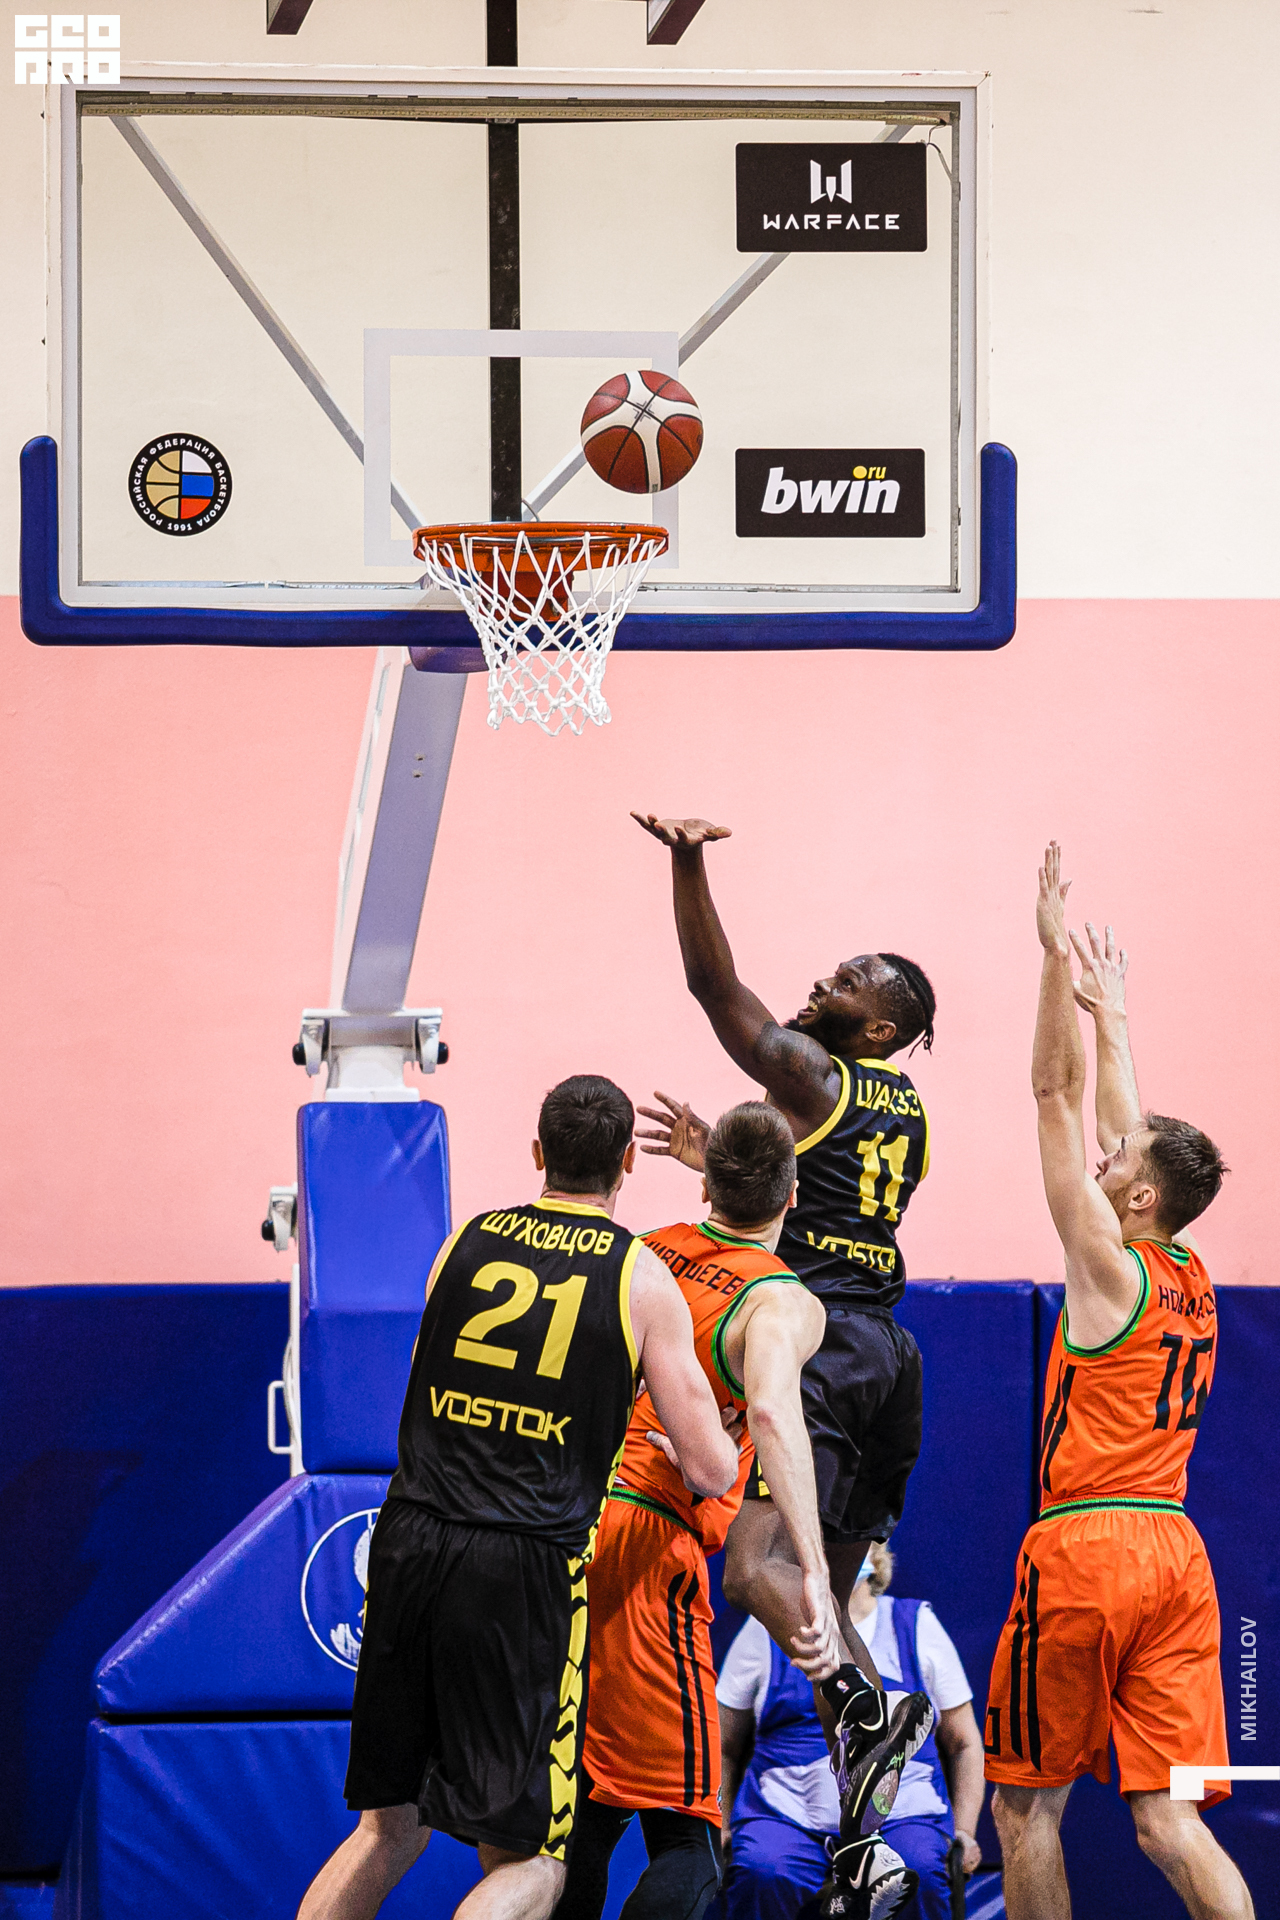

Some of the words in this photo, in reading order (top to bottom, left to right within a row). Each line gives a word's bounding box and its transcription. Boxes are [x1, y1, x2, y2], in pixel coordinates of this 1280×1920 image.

[763, 213, 900, 230] WARFACE
[149, 438, 216, 460] ФЕДЕРАЦИЯ
[133, 456, 163, 526] РОССИЙСКАЯ
[196, 461, 228, 527] БАСКЕТБОЛА
[761, 465, 901, 514] bwin
[167, 522, 193, 531] 1991
[857, 1131, 910, 1222] 11
[480, 1211, 615, 1257] ШУХОВЦОВ
[806, 1230, 896, 1274] VOSTO
[453, 1261, 588, 1380] 21
[430, 1386, 572, 1445] VOSTOK
